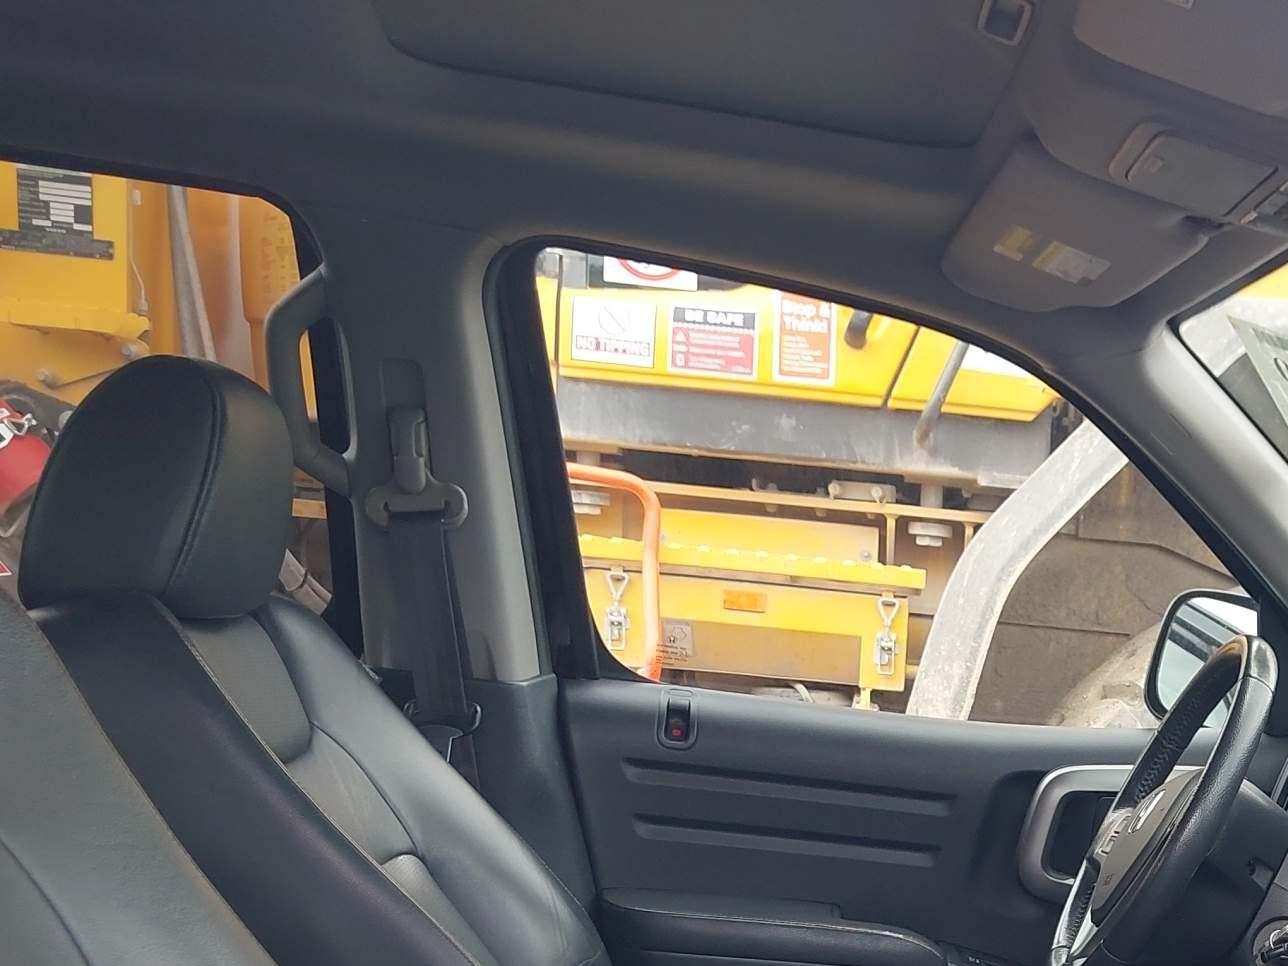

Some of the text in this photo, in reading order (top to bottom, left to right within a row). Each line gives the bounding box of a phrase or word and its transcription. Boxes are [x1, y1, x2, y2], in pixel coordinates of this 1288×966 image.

[685, 309, 744, 327] BE SAFE
[577, 337, 650, 357] NO TIPPING
